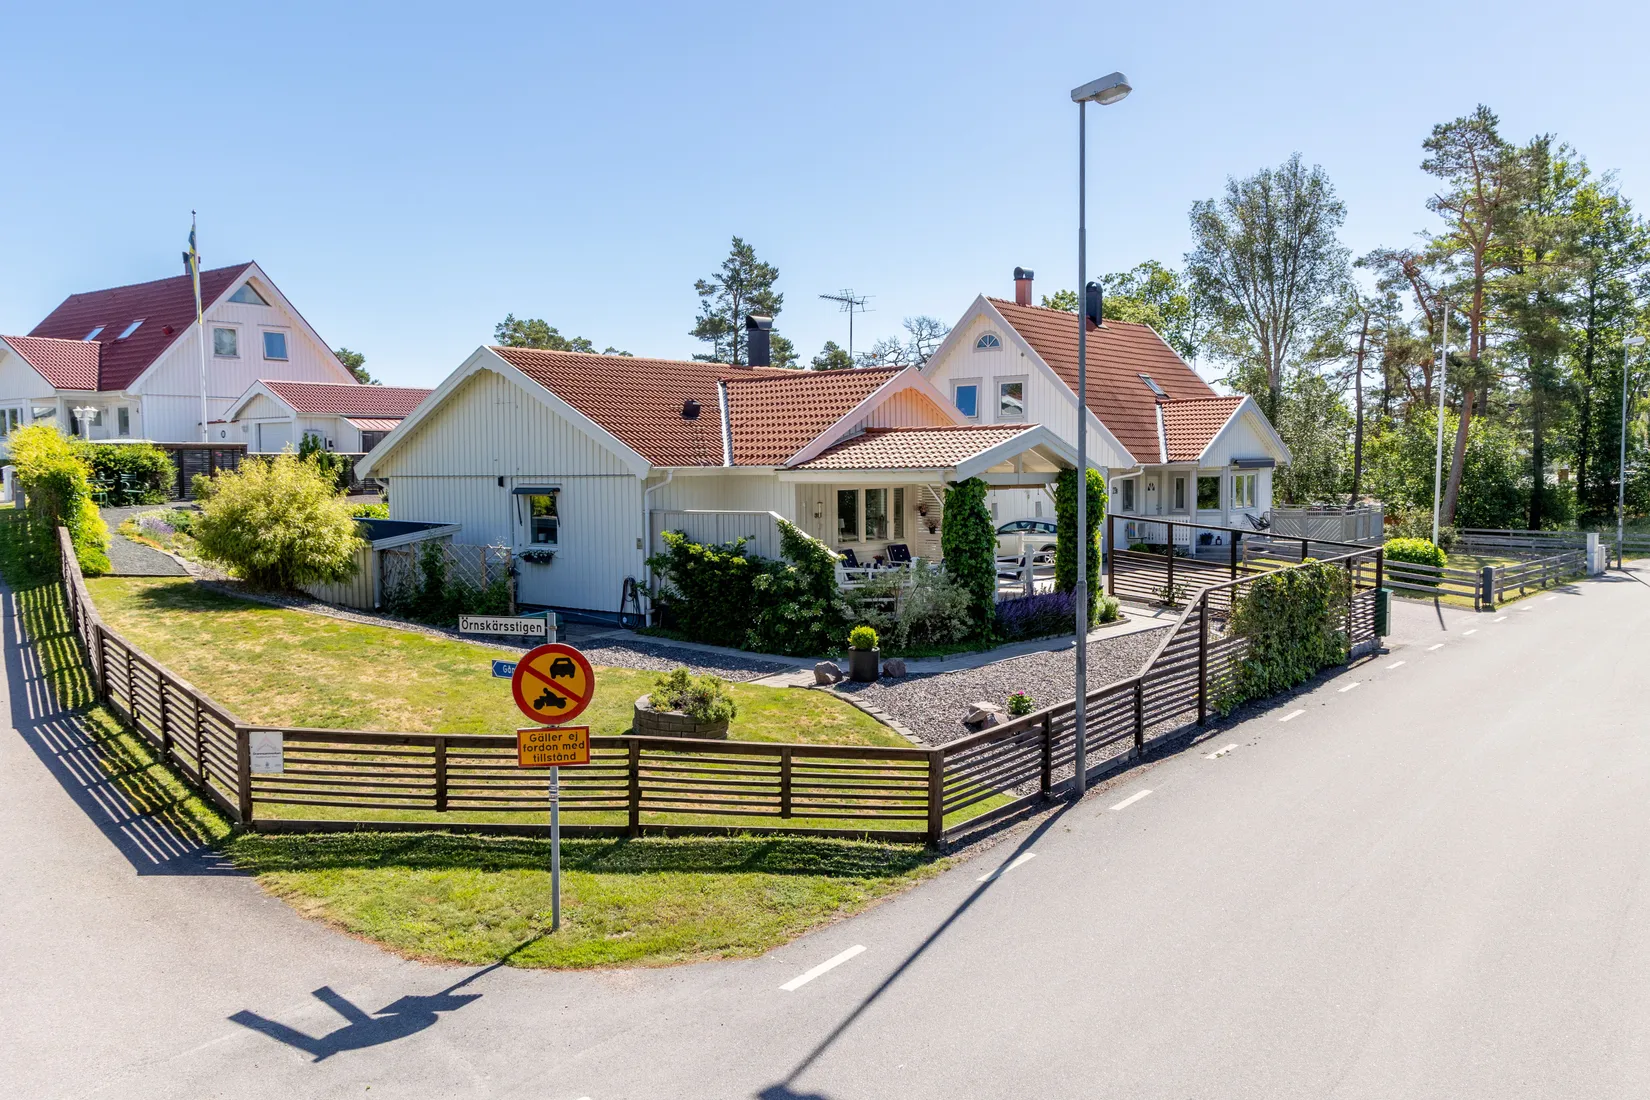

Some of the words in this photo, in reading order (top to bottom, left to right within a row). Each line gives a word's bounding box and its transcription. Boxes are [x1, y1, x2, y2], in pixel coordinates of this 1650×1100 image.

[461, 616, 542, 634] Örnskärsstigen
[529, 732, 563, 743] Gäller
[568, 731, 578, 742] ej
[523, 743, 558, 752] fordon
[562, 740, 585, 750] med
[533, 752, 576, 763] tillstånd
